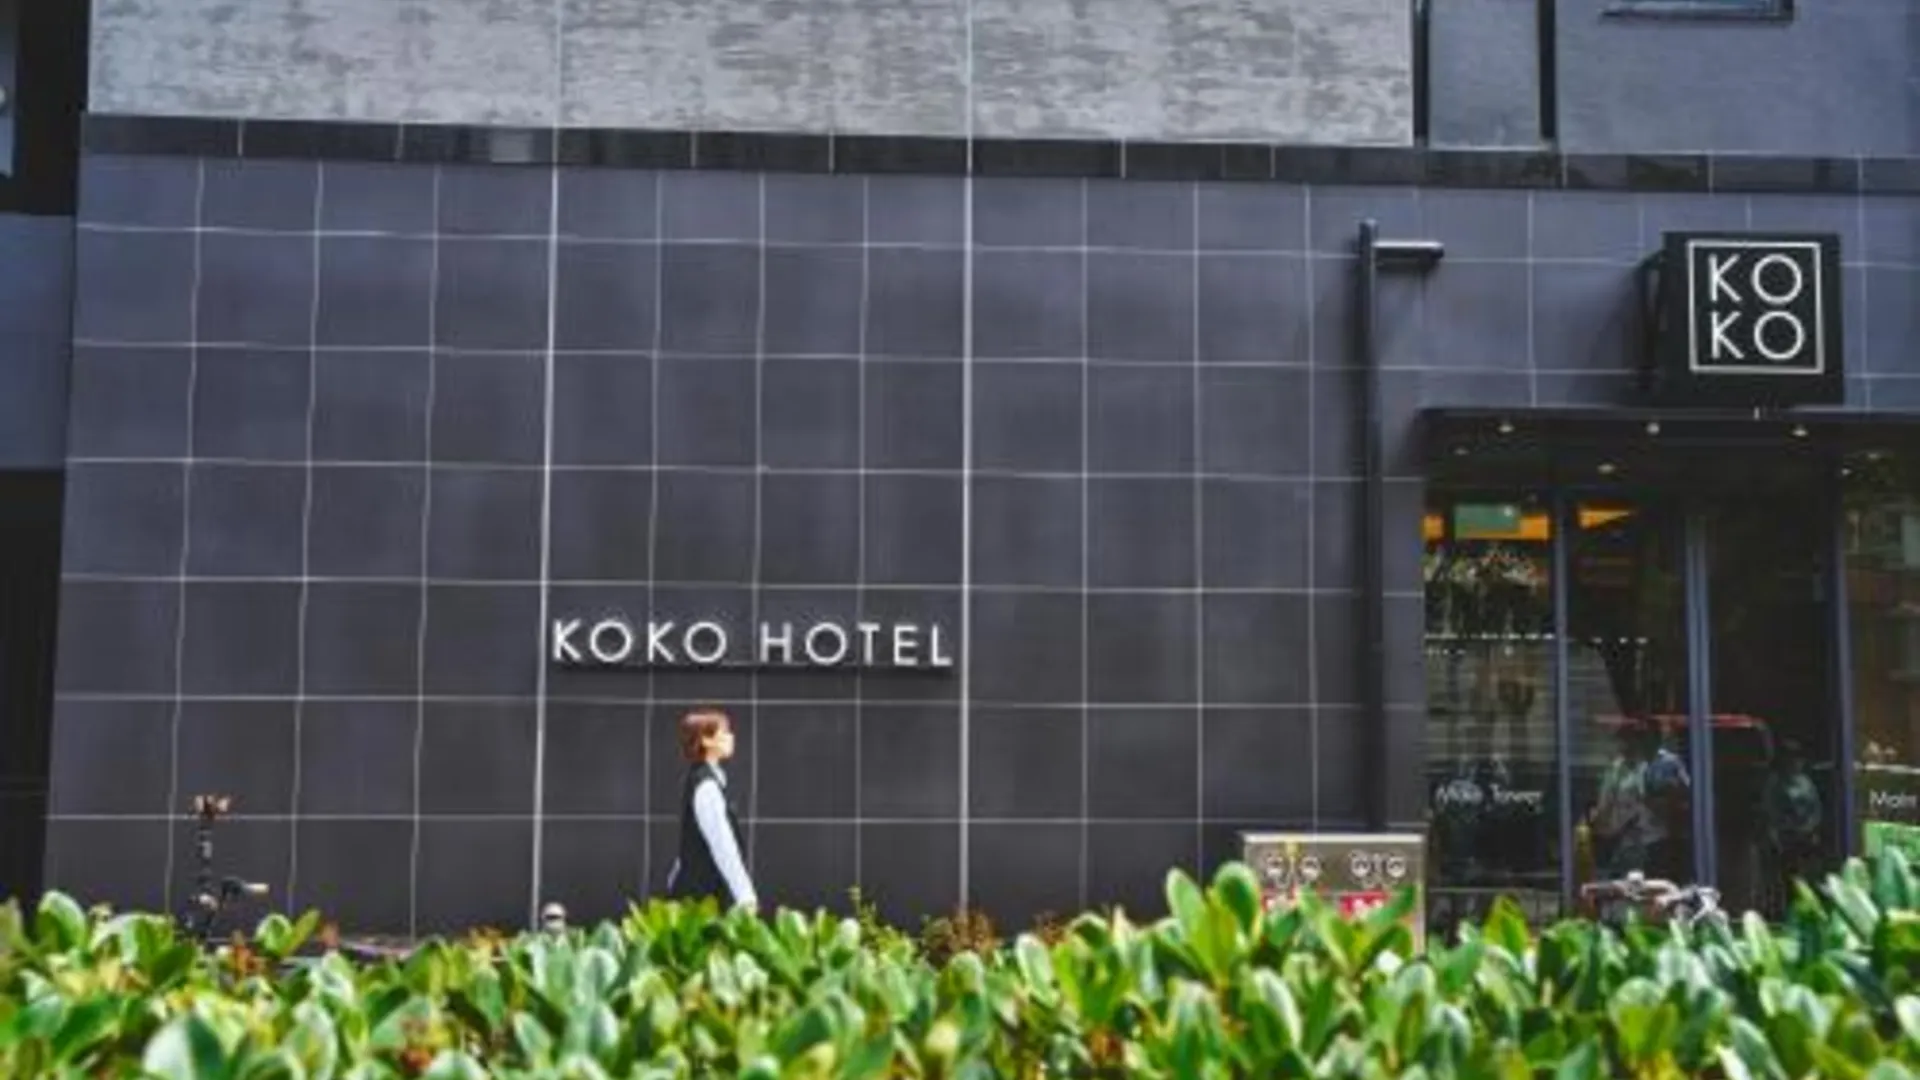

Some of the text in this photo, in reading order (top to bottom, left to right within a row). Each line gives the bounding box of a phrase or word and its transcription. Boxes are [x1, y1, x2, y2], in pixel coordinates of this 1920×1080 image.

[1709, 254, 1802, 304] KO
[1711, 311, 1805, 360] KO
[553, 619, 952, 667] KOKO HOTEL
